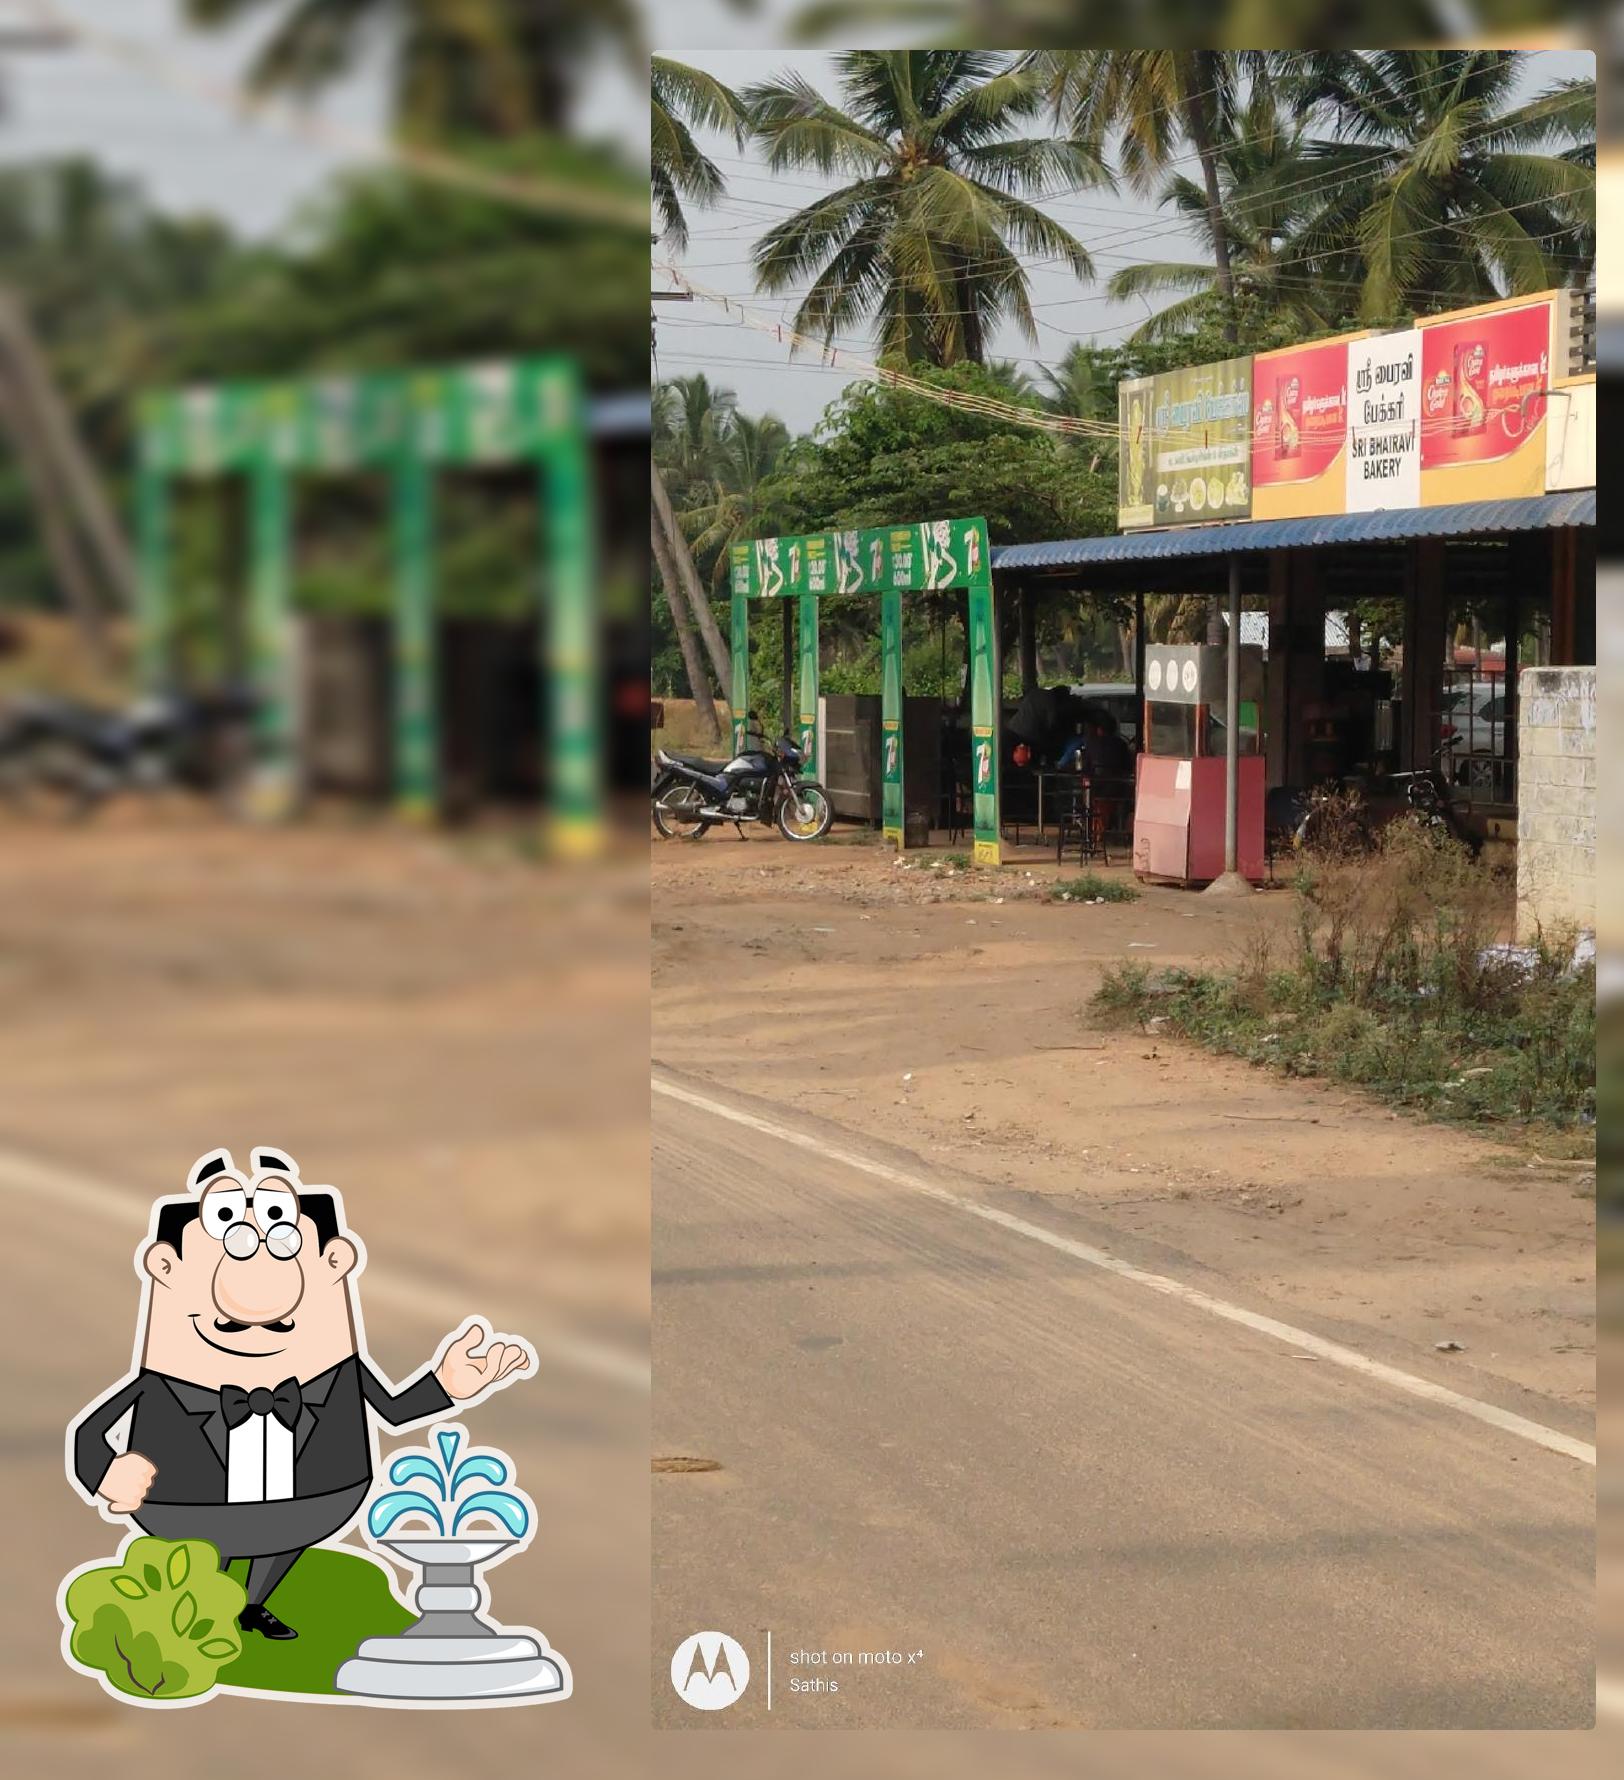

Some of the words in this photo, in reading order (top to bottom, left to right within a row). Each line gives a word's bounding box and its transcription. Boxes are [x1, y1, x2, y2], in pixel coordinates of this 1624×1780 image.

[1375, 353, 1414, 386] பைரவி
[1364, 392, 1405, 425] பேக்கரி
[1352, 438, 1367, 458] SRI
[1369, 432, 1416, 456] BHAIRAVI
[1364, 457, 1402, 480] BAKERY
